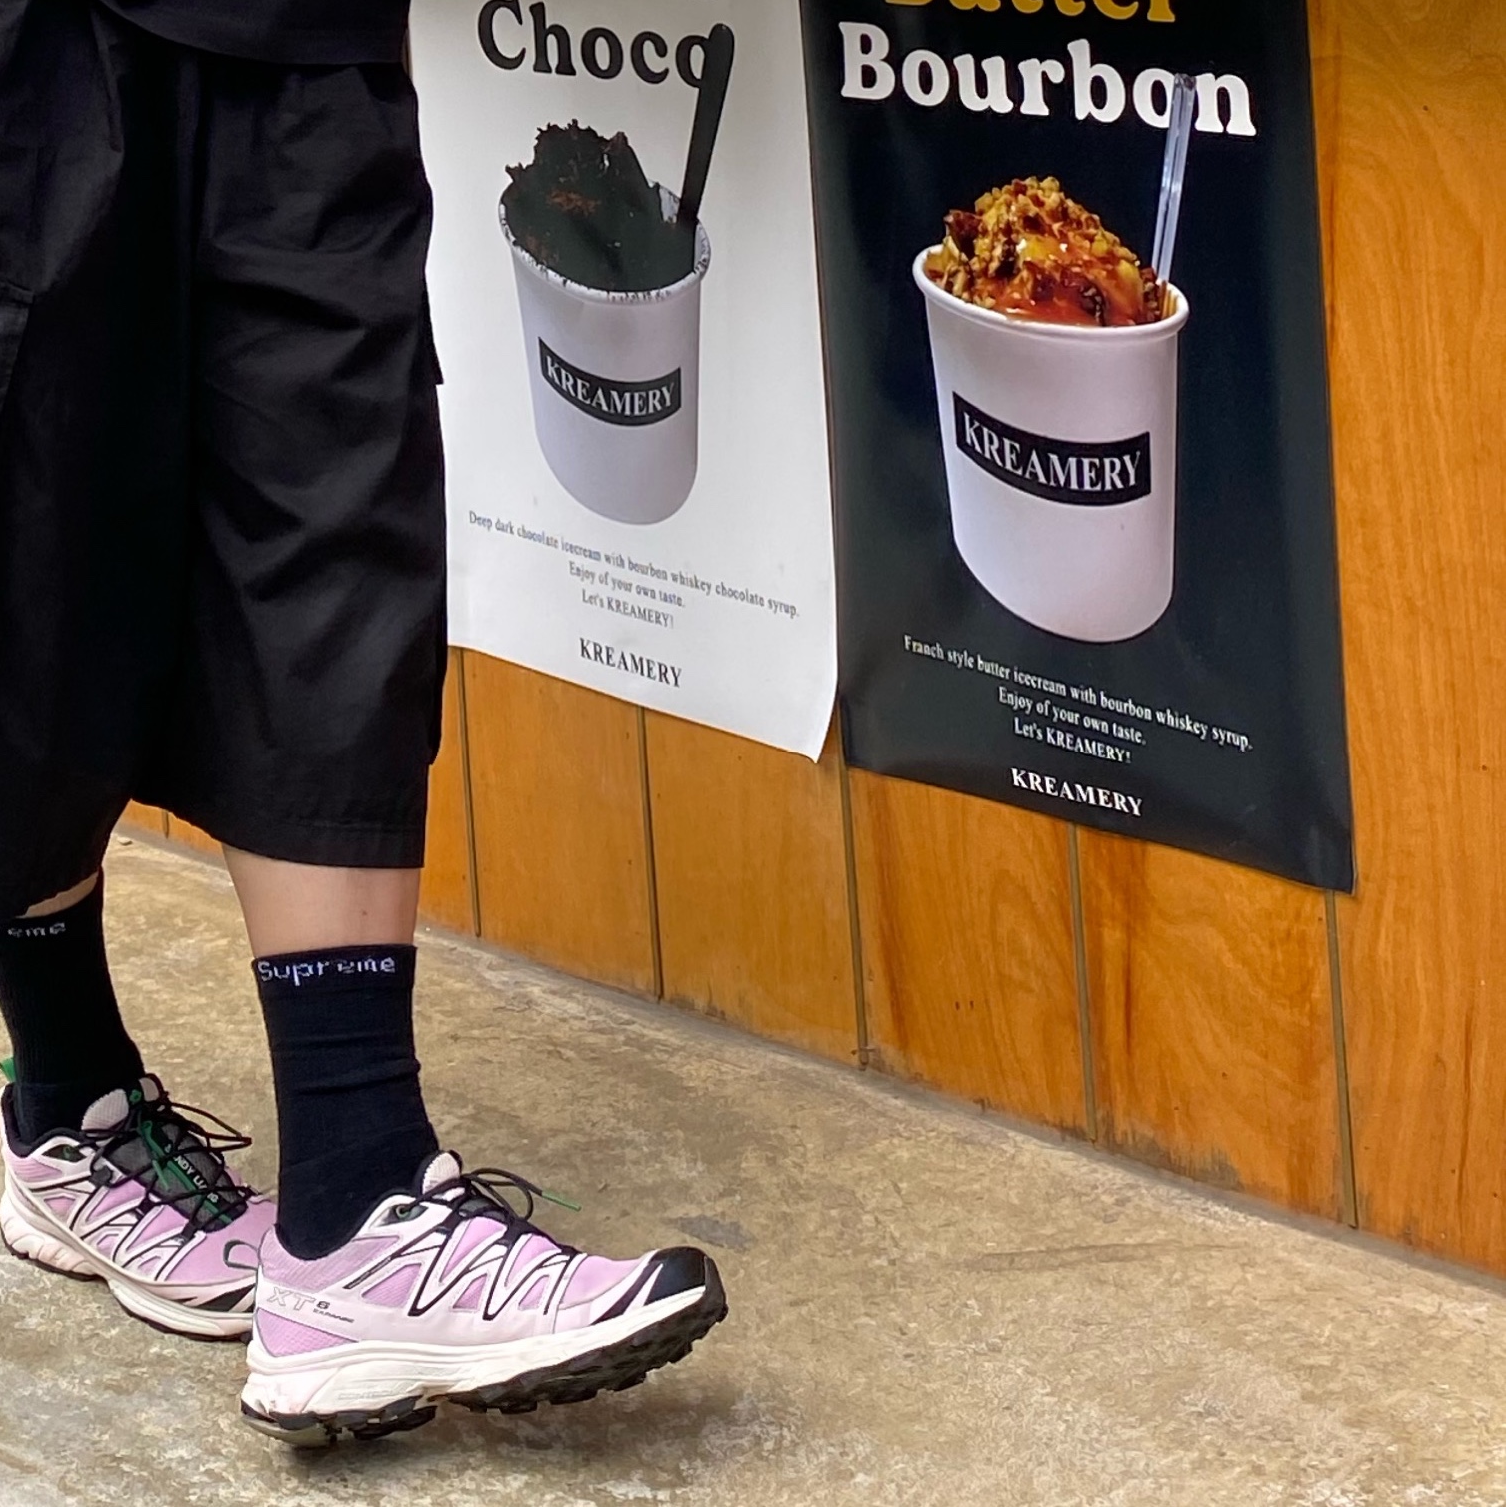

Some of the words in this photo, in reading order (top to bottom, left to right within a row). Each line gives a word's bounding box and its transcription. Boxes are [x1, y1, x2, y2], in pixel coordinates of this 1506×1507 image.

[838, 21, 1257, 137] Bourbon
[544, 354, 676, 417] KREAMERY
[961, 412, 1142, 492] KREAMERY
[469, 510, 493, 531] Deep
[494, 518, 515, 536] dark
[516, 525, 559, 549] chocolate
[561, 537, 602, 563] icecream
[603, 552, 626, 570] with
[627, 555, 669, 582] bourbon
[670, 570, 712, 597] whiskey
[714, 581, 765, 608] chocolate
[569, 560, 596, 585] Enjoy
[598, 571, 610, 586] of
[611, 577, 633, 593] your
[635, 584, 657, 600] own
[582, 588, 604, 608] Let's
[606, 596, 674, 628] KREAMERY!
[579, 637, 681, 688] KREAMERY
[947, 650, 975, 669] style
[977, 654, 1011, 680] butter
[1013, 666, 1067, 697] icecream
[1069, 685, 1097, 706] with
[1099, 690, 1152, 721] bourbon
[1155, 708, 1208, 740] whiskey
[1211, 727, 1253, 753] syrup.
[998, 686, 1033, 715] Enjoy
[1036, 699, 1051, 716] of
[1052, 706, 1080, 725] your
[1083, 716, 1109, 734] own
[1112, 722, 1146, 745] taste.
[1014, 717, 1043, 740] Let's
[1046, 726, 1131, 762] KREAMERY!
[1011, 767, 1142, 816] KREAMERY
